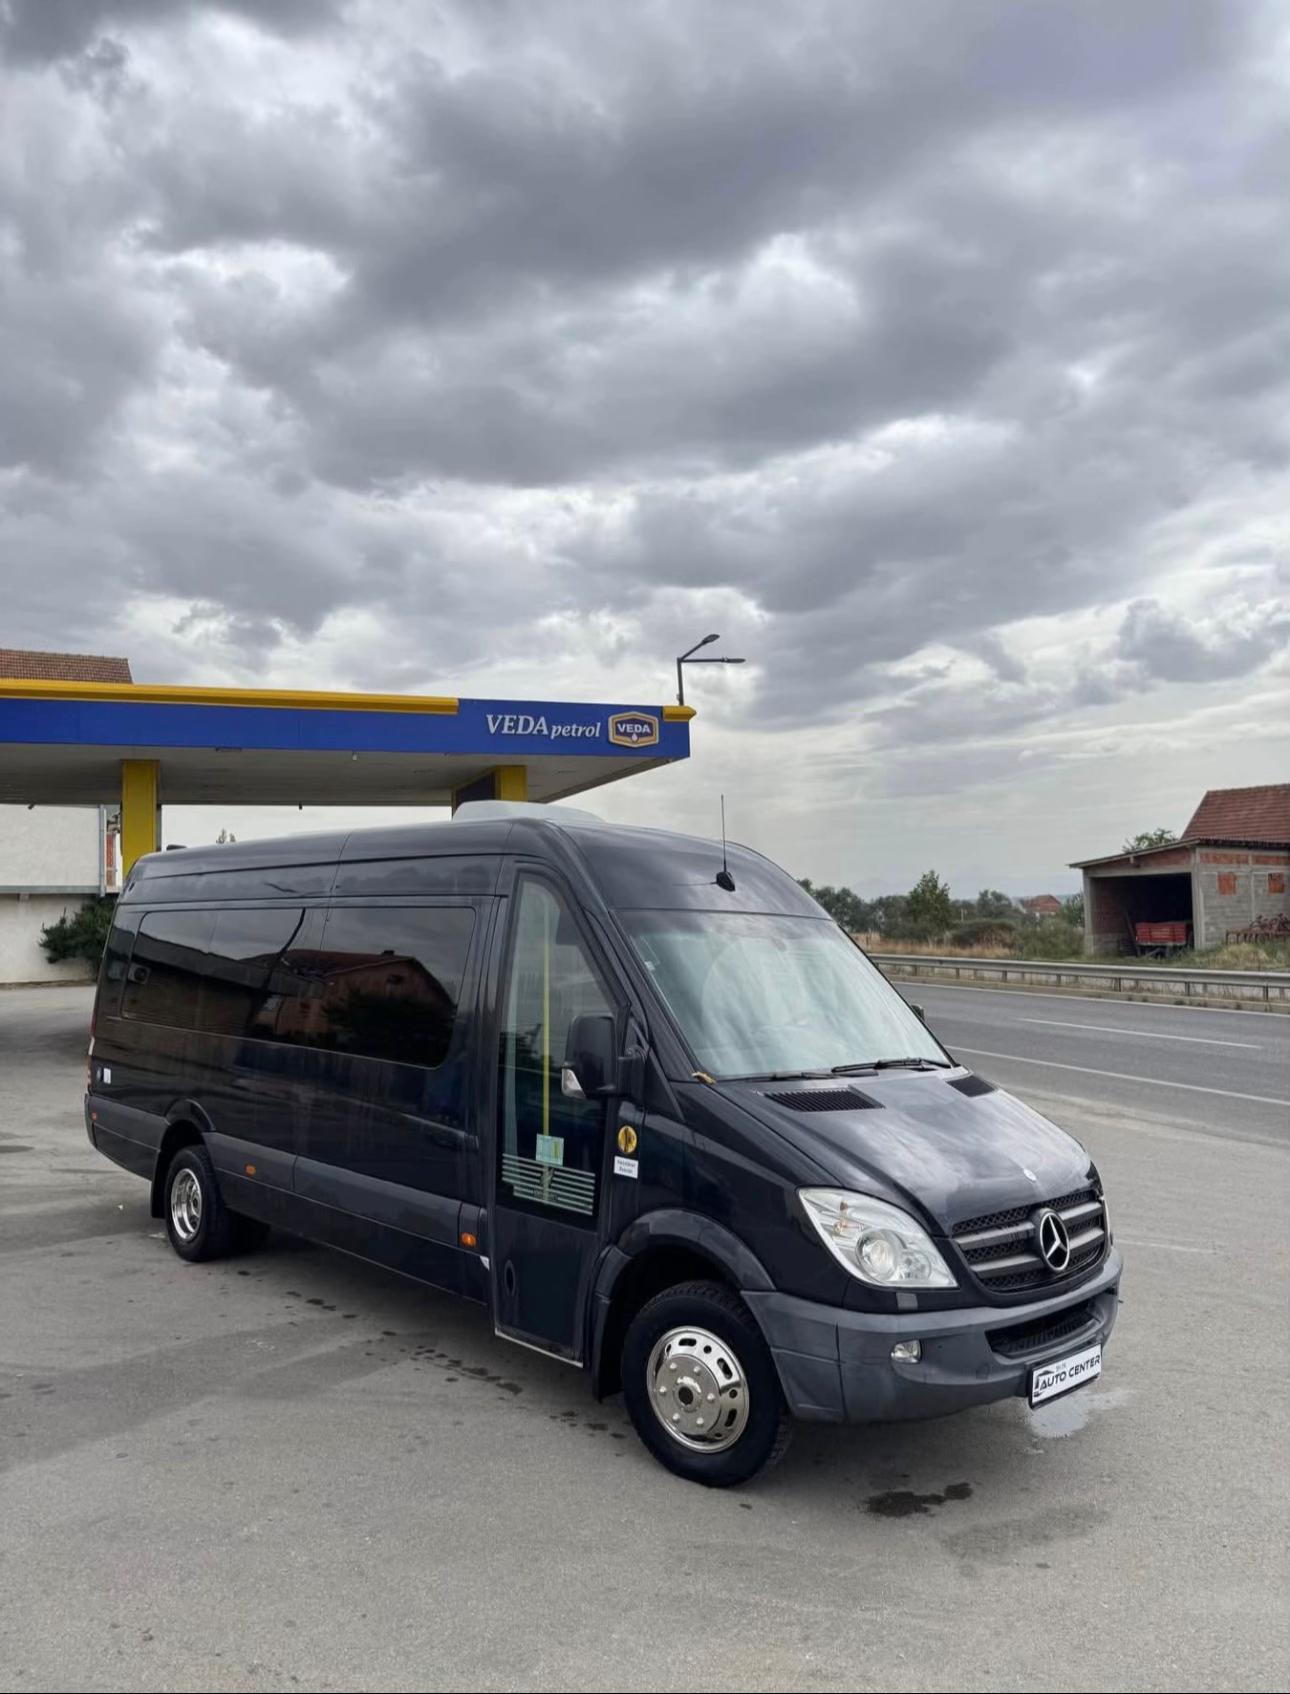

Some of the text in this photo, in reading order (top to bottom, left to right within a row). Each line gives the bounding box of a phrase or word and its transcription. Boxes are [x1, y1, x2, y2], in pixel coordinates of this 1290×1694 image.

[486, 714, 600, 739] VEDA petrol
[617, 723, 651, 733] VEDA
[1040, 1371, 1067, 1390] AUTO
[1068, 1354, 1100, 1378] CENTER
